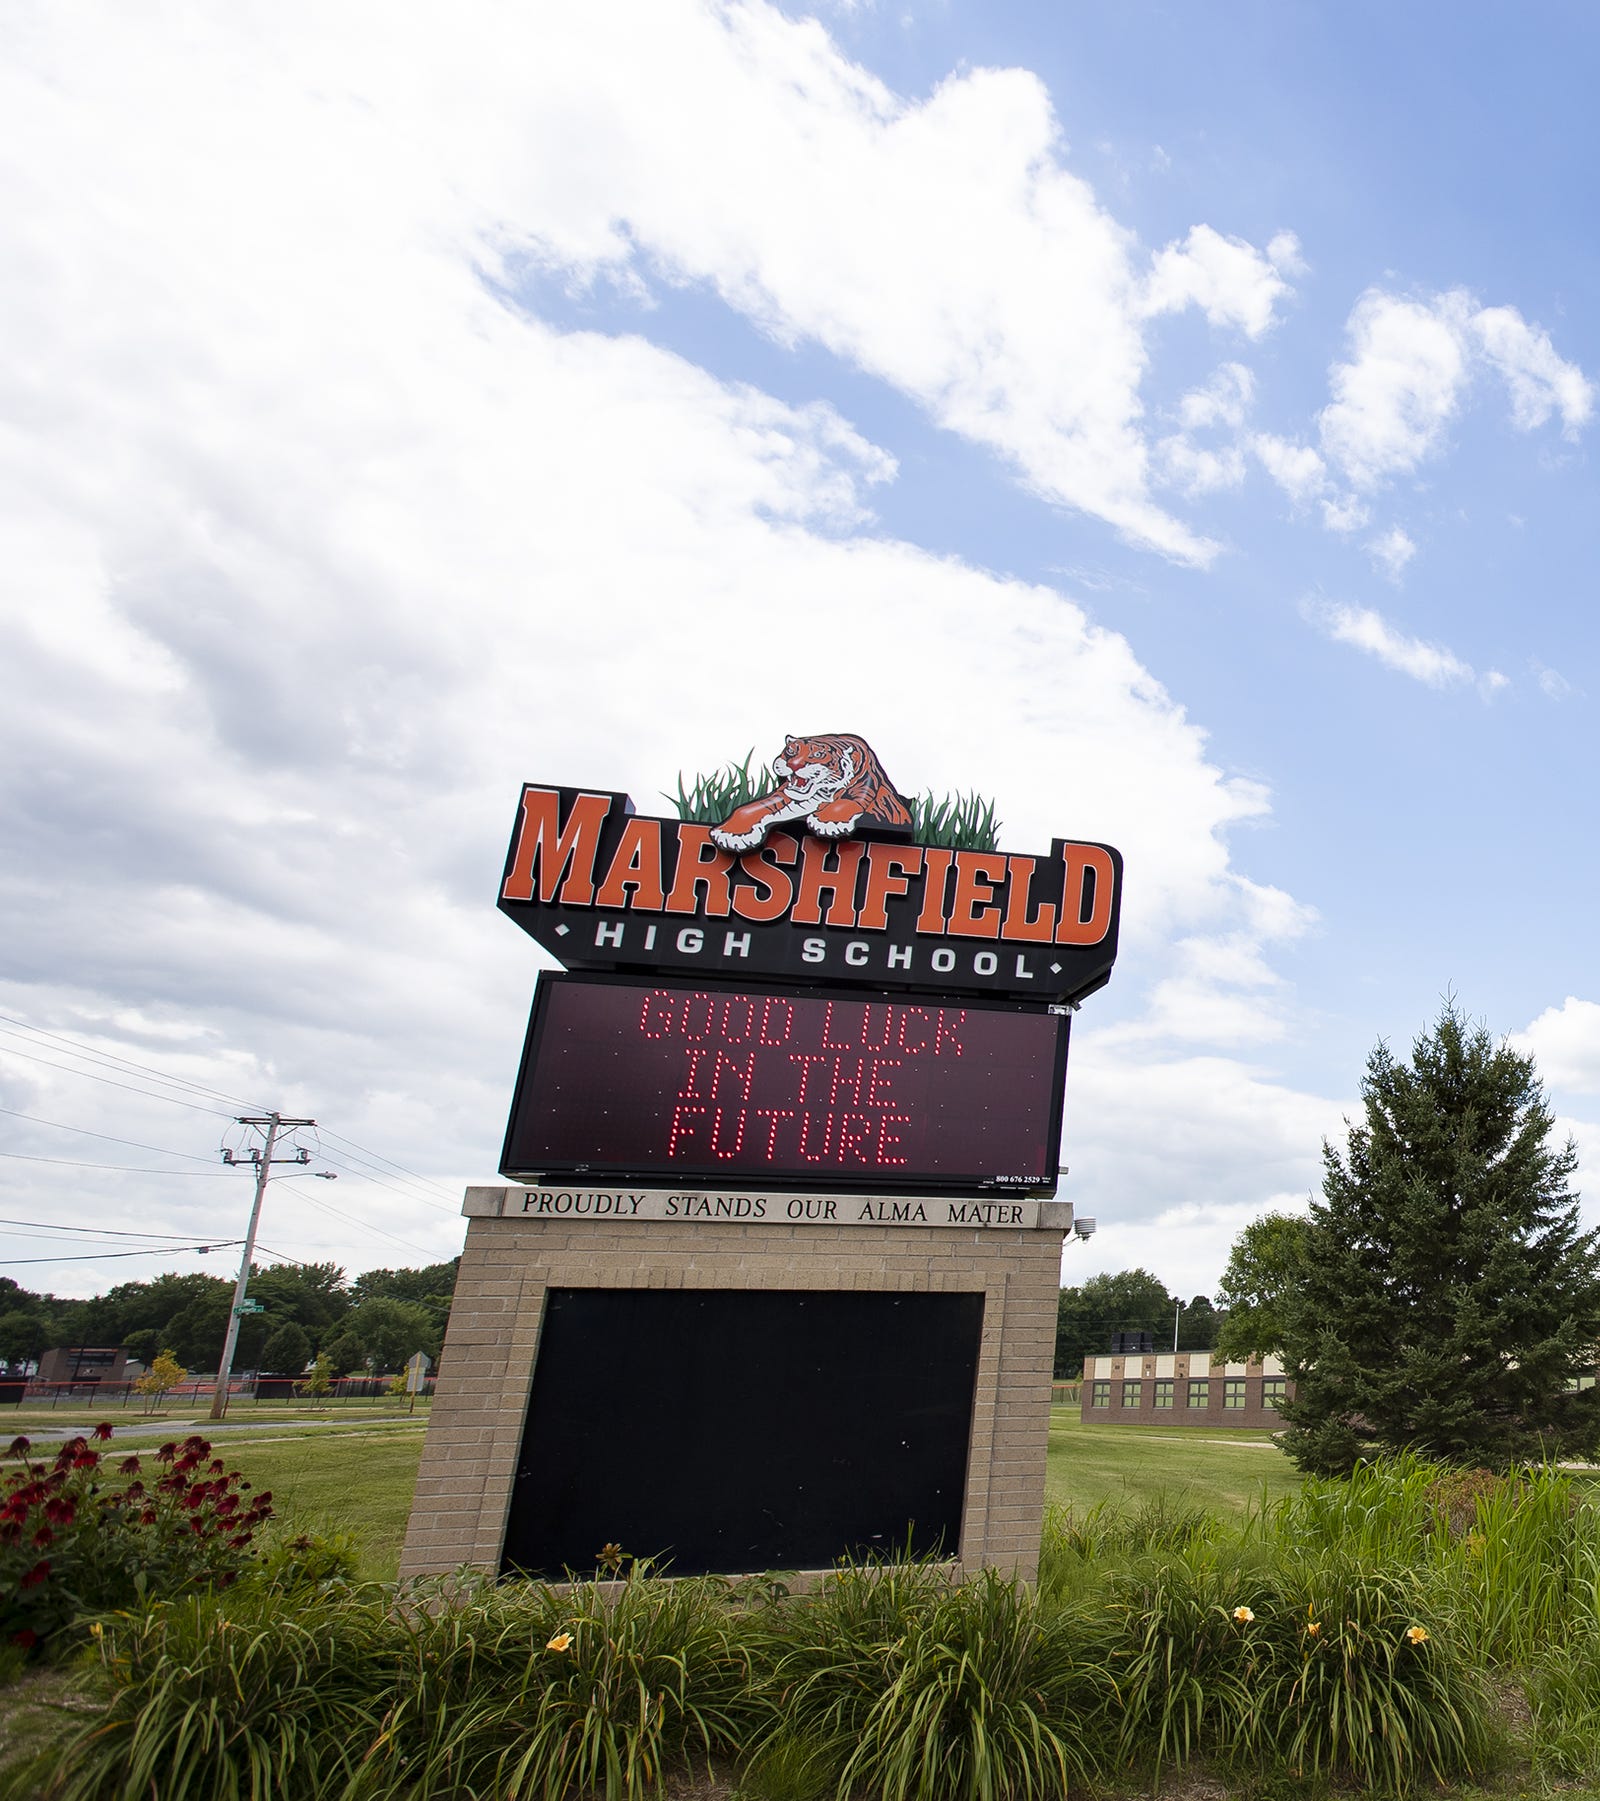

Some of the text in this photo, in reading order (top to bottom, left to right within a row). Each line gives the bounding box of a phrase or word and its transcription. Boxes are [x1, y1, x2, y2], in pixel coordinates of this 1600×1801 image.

[501, 788, 1116, 946] MARSHFIELD
[595, 922, 1034, 980] HIGH SCHOOL
[639, 988, 967, 1057] GOOD LUCK
[677, 1048, 902, 1108] IN THE
[667, 1105, 912, 1165] FUTURE
[521, 1192, 1024, 1224] PROUDLY STANDS OUR ALMA MATER
[995, 1175, 1009, 1183] 800
[1010, 1175, 1023, 1183] 676
[1023, 1175, 1041, 1184] 2529
